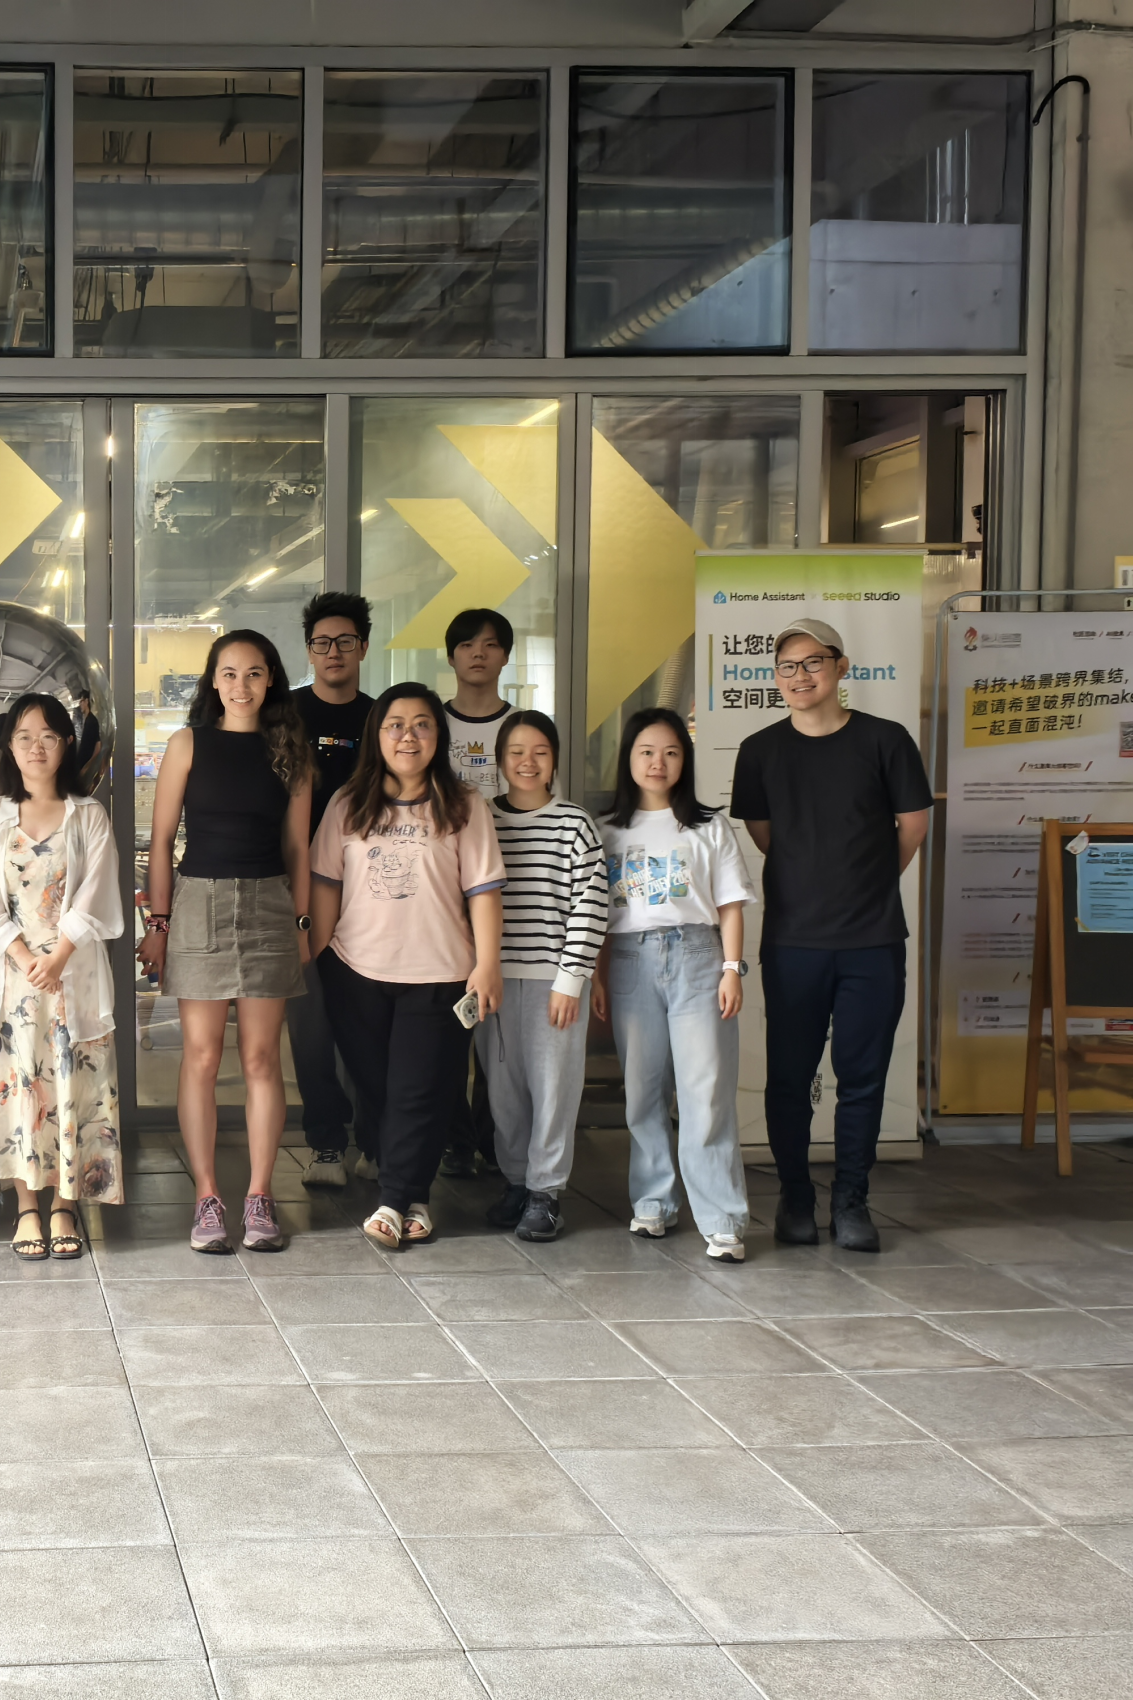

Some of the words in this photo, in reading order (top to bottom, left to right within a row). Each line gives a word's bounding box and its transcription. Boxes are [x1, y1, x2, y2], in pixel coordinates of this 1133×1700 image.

[730, 592, 759, 602] Home
[762, 591, 805, 602] Assistant
[822, 591, 861, 602] seeed
[864, 591, 900, 602] studio
[723, 665, 774, 681] Hom
